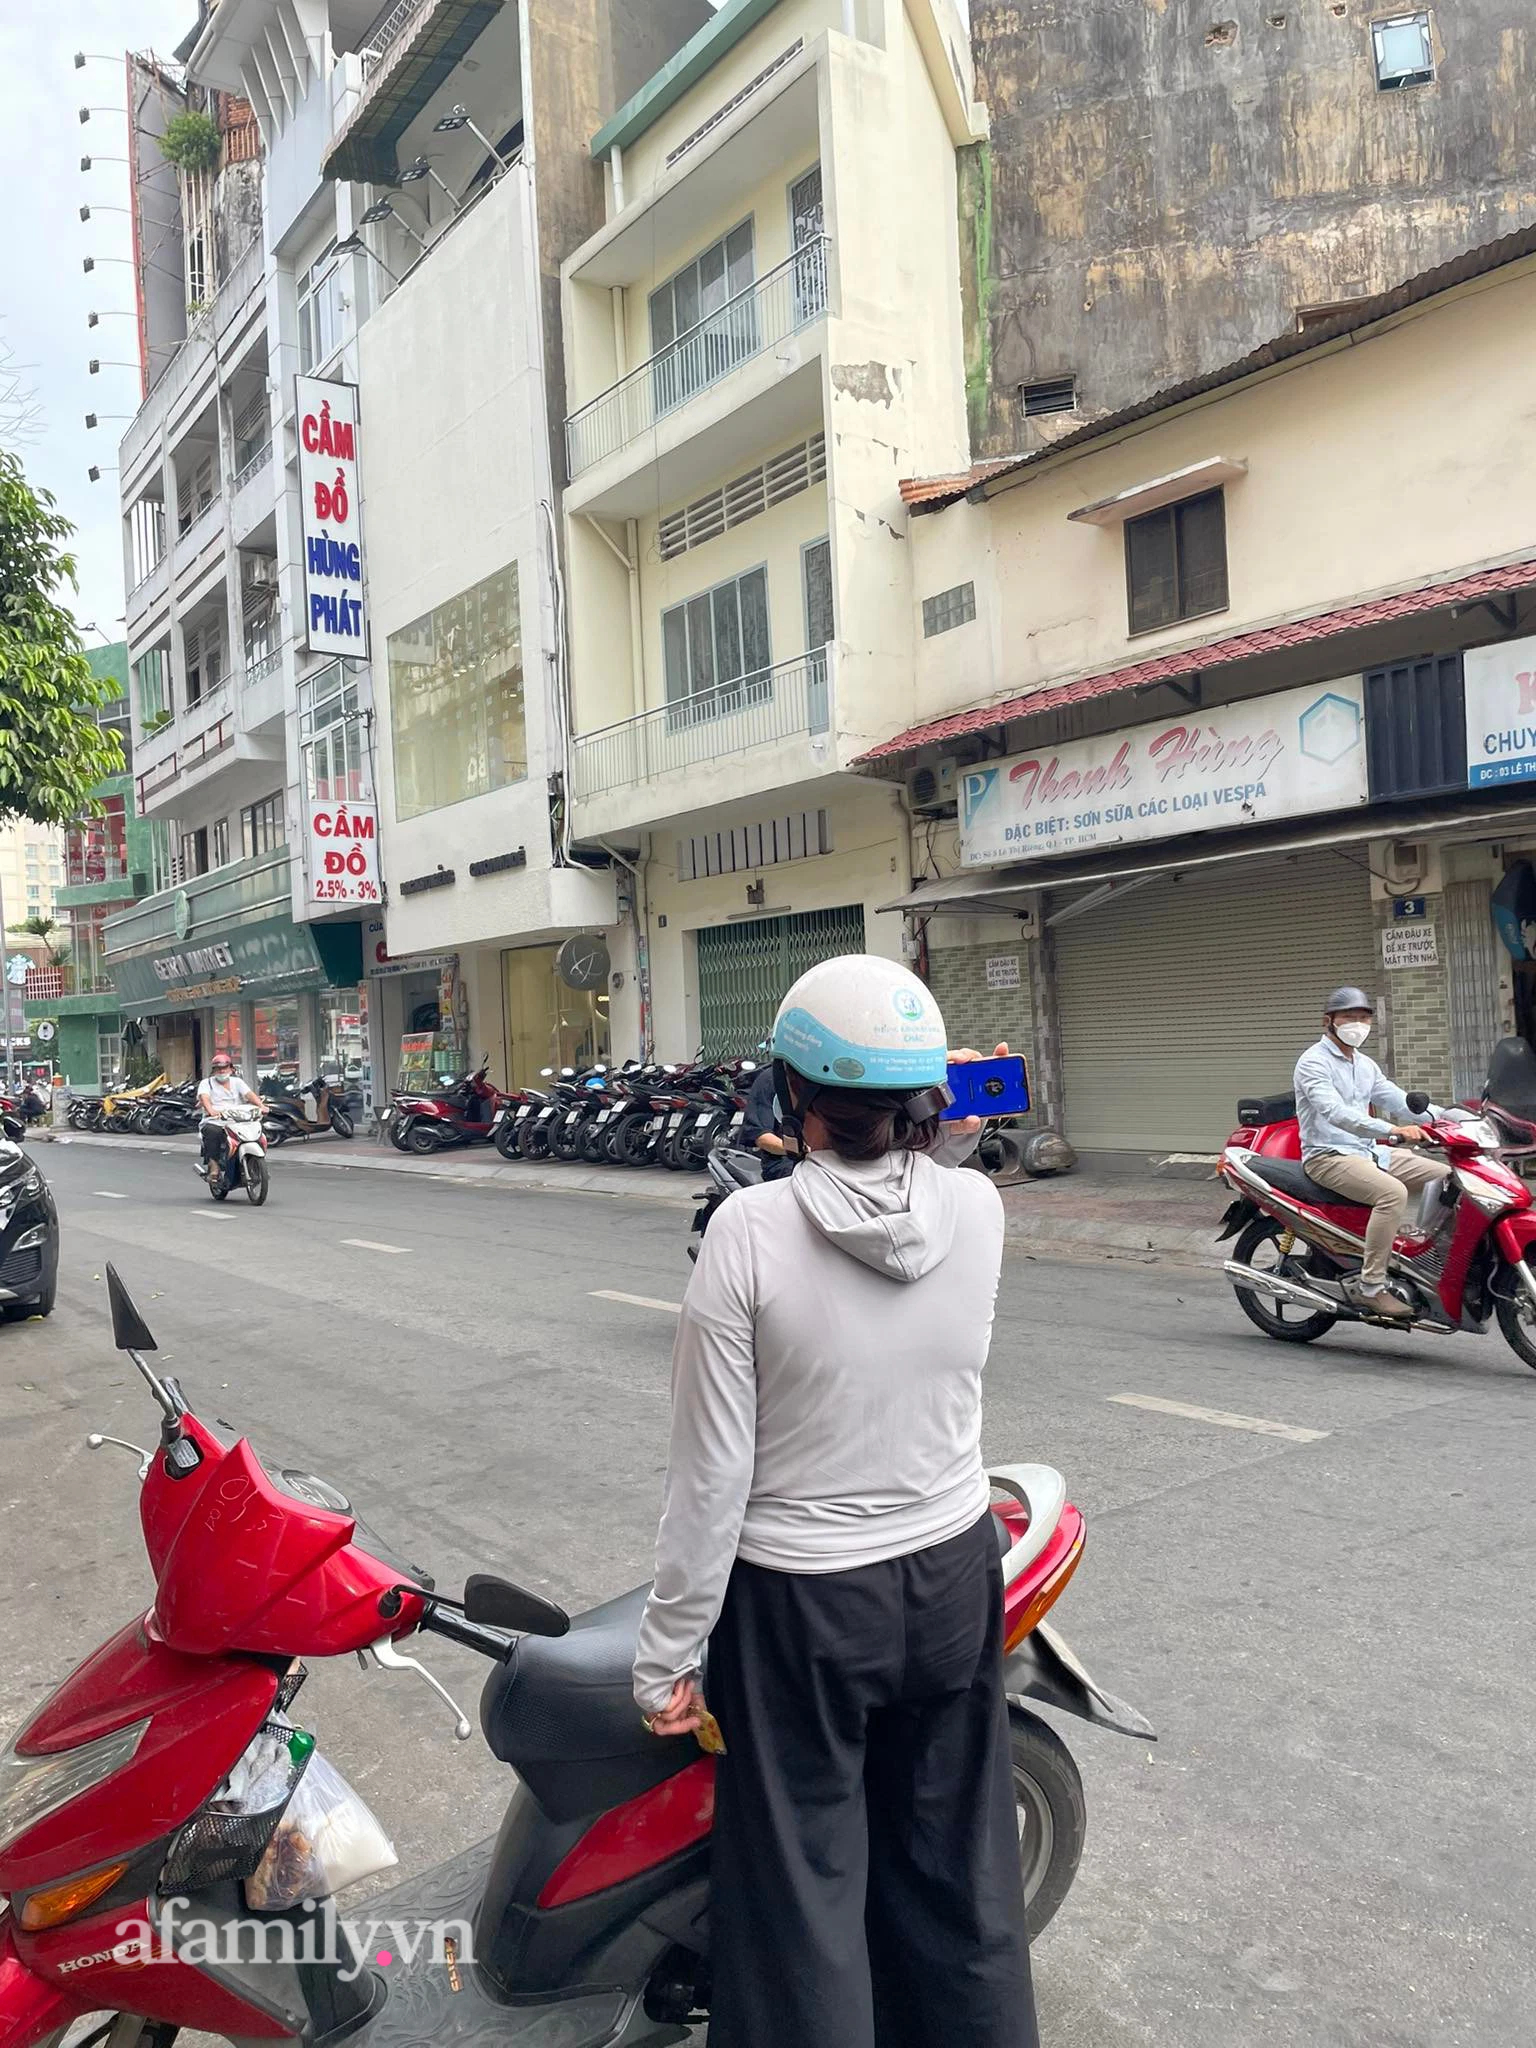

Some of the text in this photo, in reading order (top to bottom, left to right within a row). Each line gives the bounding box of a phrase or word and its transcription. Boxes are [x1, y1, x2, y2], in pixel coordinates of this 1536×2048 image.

[302, 400, 354, 461] CẦM
[314, 468, 349, 523] ĐỒ
[307, 529, 361, 581] HÙNG
[310, 590, 362, 637] PHÁT
[1009, 726, 1285, 810] Thanh Hùng
[1500, 766, 1509, 776] 03
[1511, 762, 1522, 775] LÊ
[313, 804, 374, 838] CẦM
[1005, 824, 1031, 842] ĐẶC
[1035, 815, 1070, 836] BIỆT:
[1074, 810, 1101, 829] SƠN
[1138, 797, 1168, 818] CÁC
[1173, 791, 1209, 811] LOẠI
[1213, 782, 1267, 805] VESPA
[1079, 833, 1097, 844] HCM
[324, 842, 367, 876] ĐỒ
[316, 880, 347, 898] 2.5%
[358, 881, 377, 899] 3%
[1404, 901, 1415, 914] 3
[1386, 929, 1403, 941] CẤM
[1423, 927, 1432, 937] XE
[1397, 943, 1406, 952] XE
[1408, 940, 1434, 951] TRƯỚC
[1403, 951, 1419, 963] TIỀN
[1421, 951, 1438, 962] NHÀ
[57, 1940, 147, 1973] HONDA
